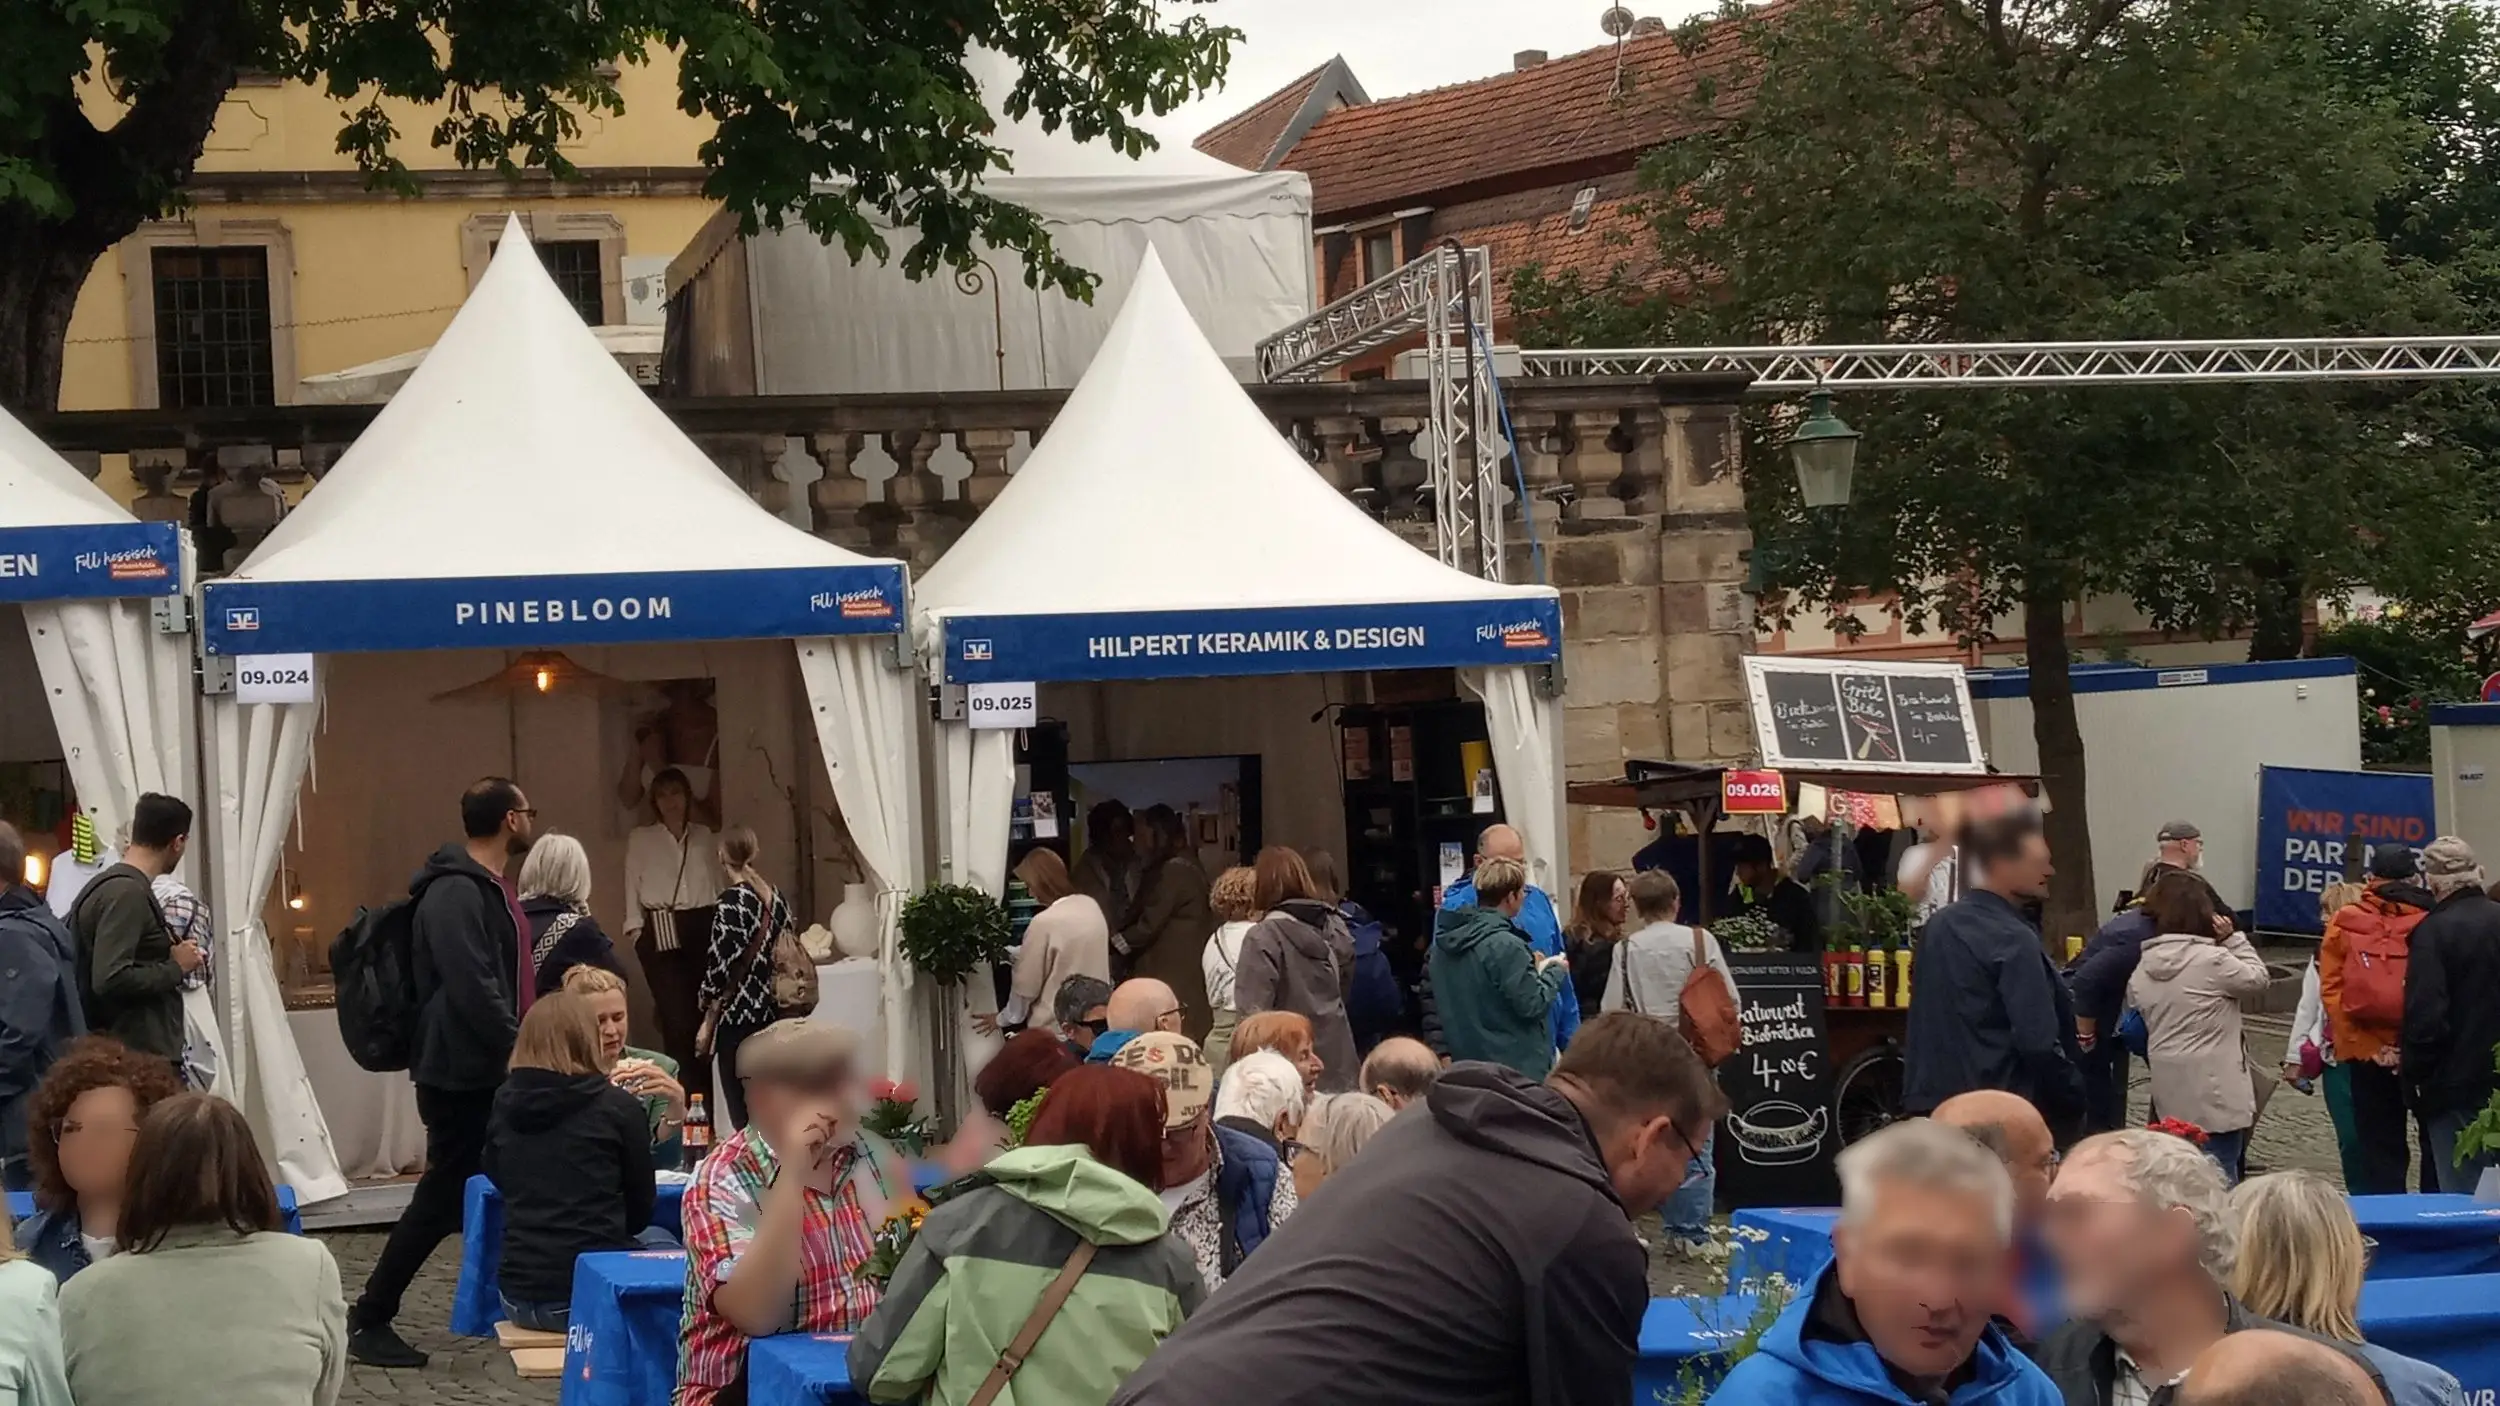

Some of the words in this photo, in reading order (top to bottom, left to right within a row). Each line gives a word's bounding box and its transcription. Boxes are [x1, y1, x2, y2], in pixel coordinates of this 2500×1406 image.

[103, 544, 157, 566] hessisch
[835, 585, 884, 606] hessisch
[456, 597, 671, 625] PINEBLOOM
[1089, 634, 1193, 658] HILPERT
[1198, 630, 1309, 654] KERAMIK
[1314, 629, 1331, 650] &
[1335, 626, 1425, 649] DESIGN
[241, 669, 310, 685] 09.024
[972, 696, 1032, 711] 09.025
[1726, 784, 1781, 797] 09.026
[2286, 808, 2345, 835] WIR
[2352, 812, 2426, 842] SIND
[1737, 992, 1808, 1023] ratwurst
